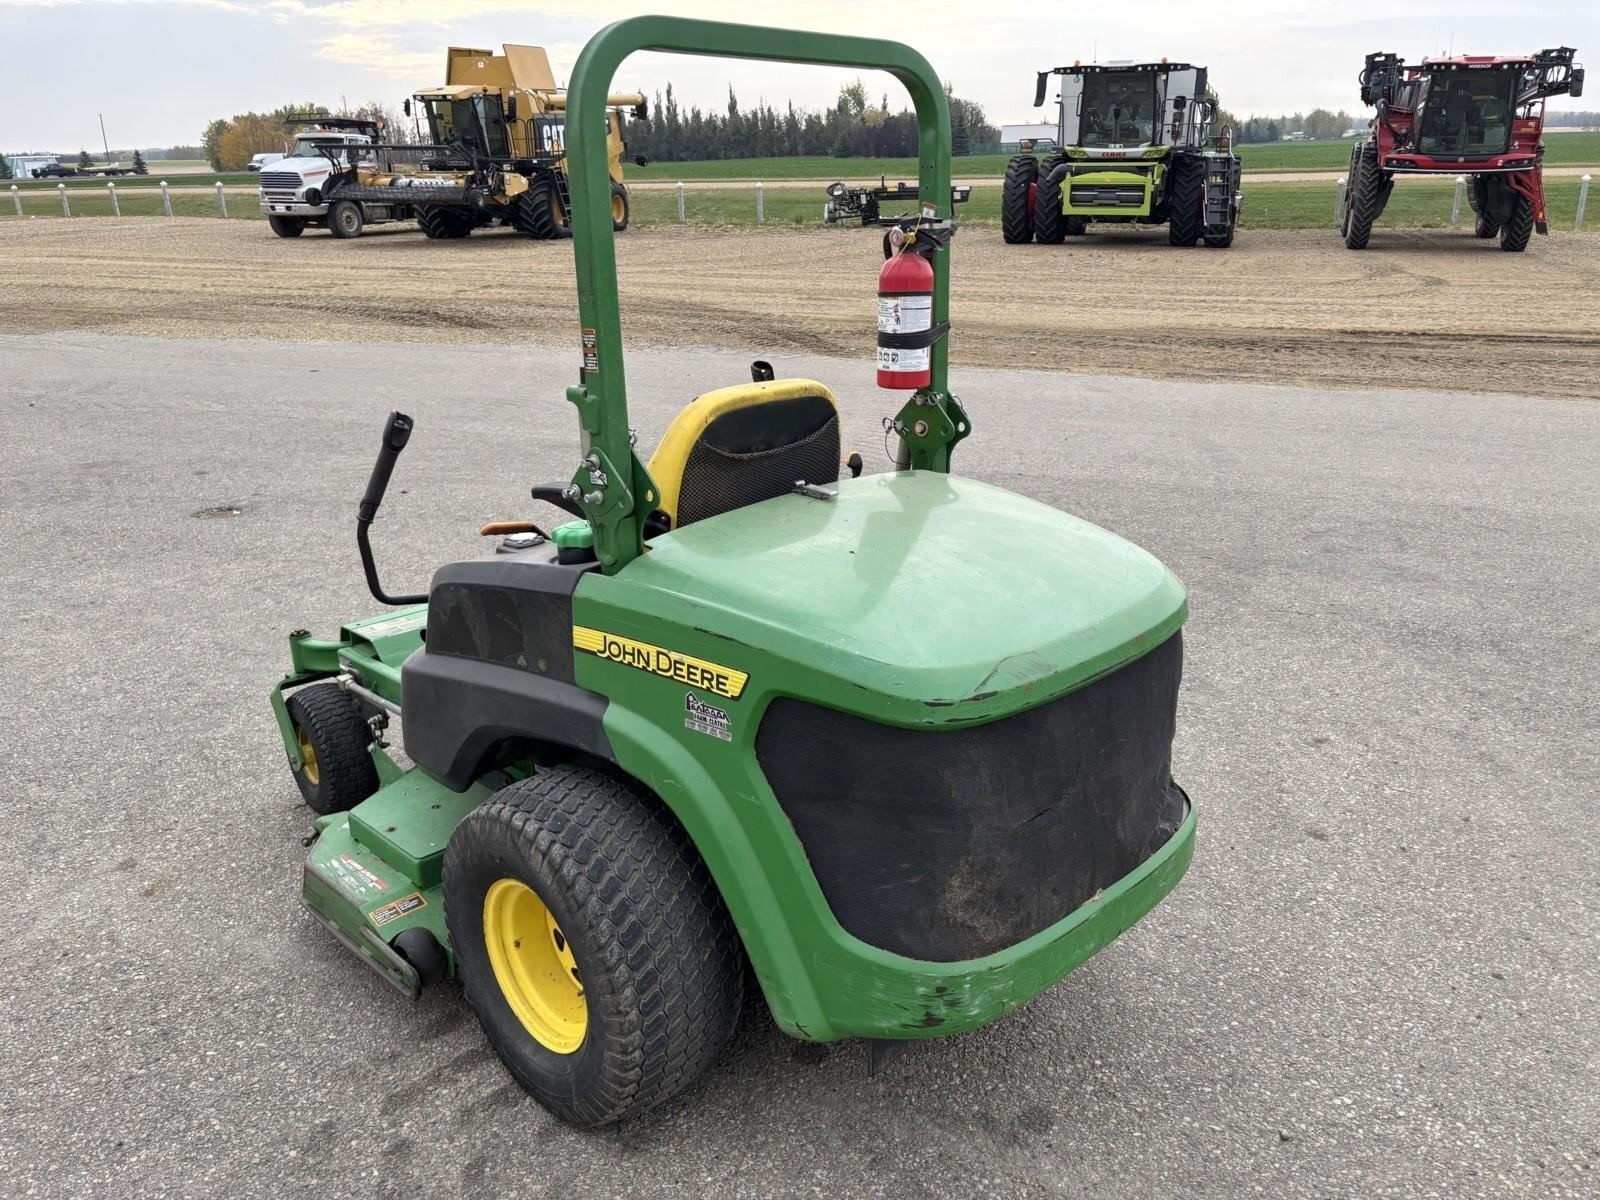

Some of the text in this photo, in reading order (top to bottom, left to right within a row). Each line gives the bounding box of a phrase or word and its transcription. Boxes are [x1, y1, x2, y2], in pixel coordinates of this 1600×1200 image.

[542, 124, 565, 152] CAT
[597, 635, 729, 694] JOHN DEERE
